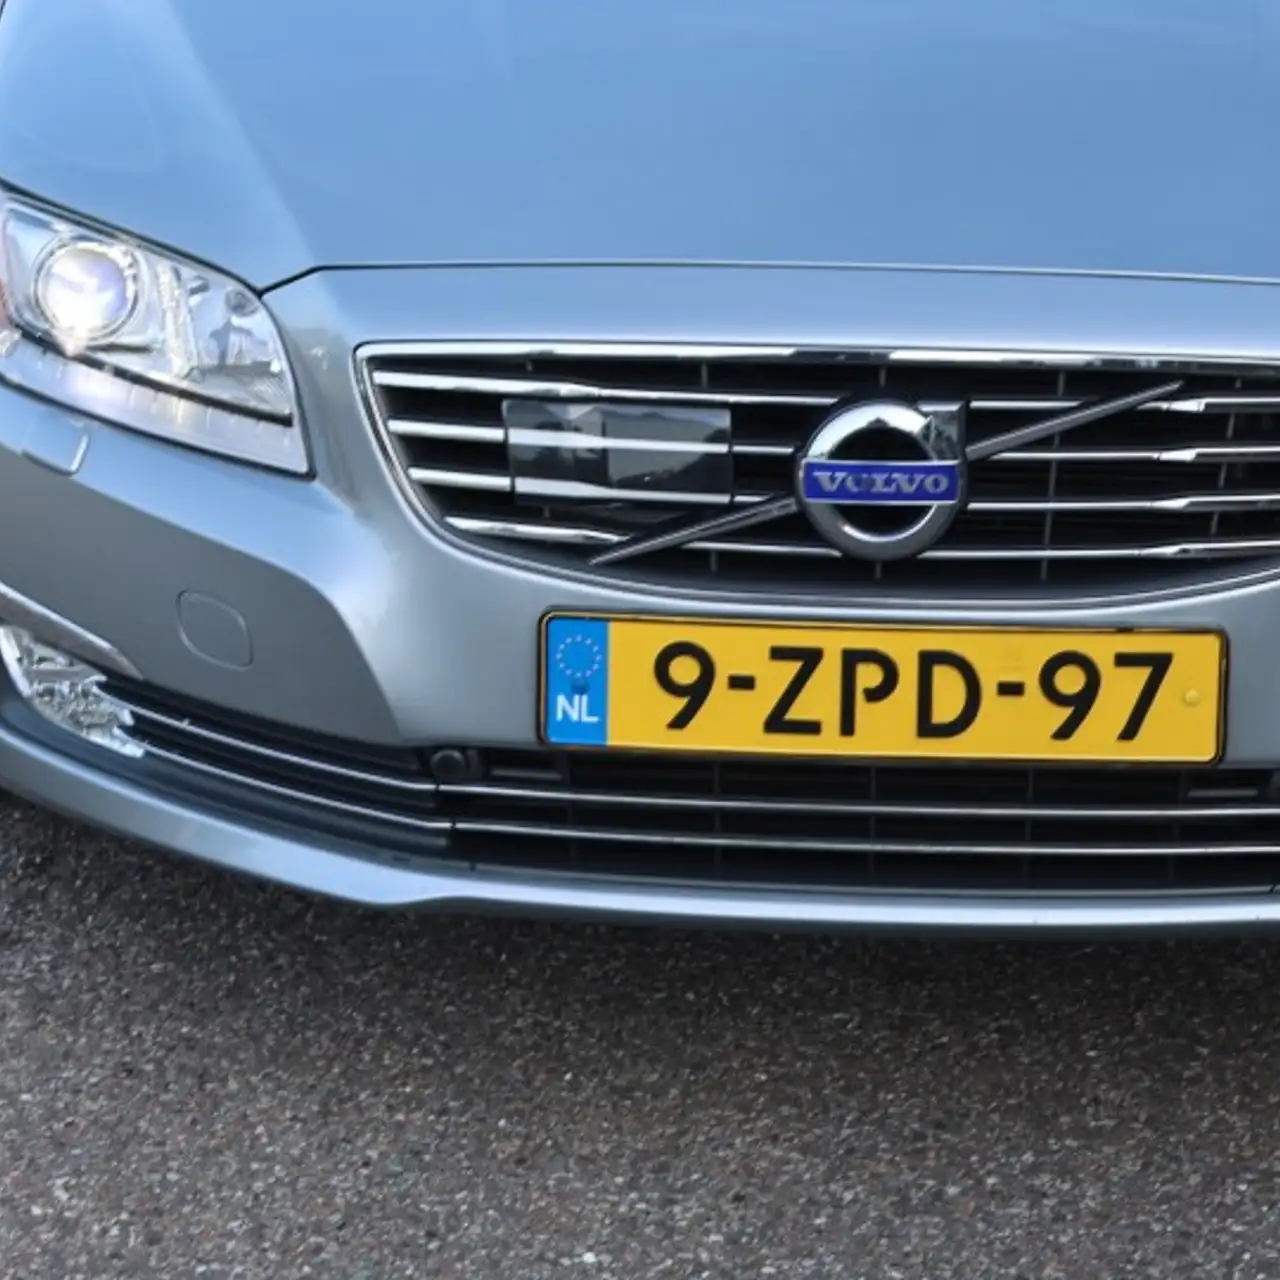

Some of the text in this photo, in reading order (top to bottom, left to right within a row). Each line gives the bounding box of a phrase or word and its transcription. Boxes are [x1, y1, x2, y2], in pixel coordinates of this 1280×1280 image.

[812, 469, 950, 494] VOLVO
[652, 640, 1175, 742] 9-ZPD-97
[555, 693, 600, 723] NL
